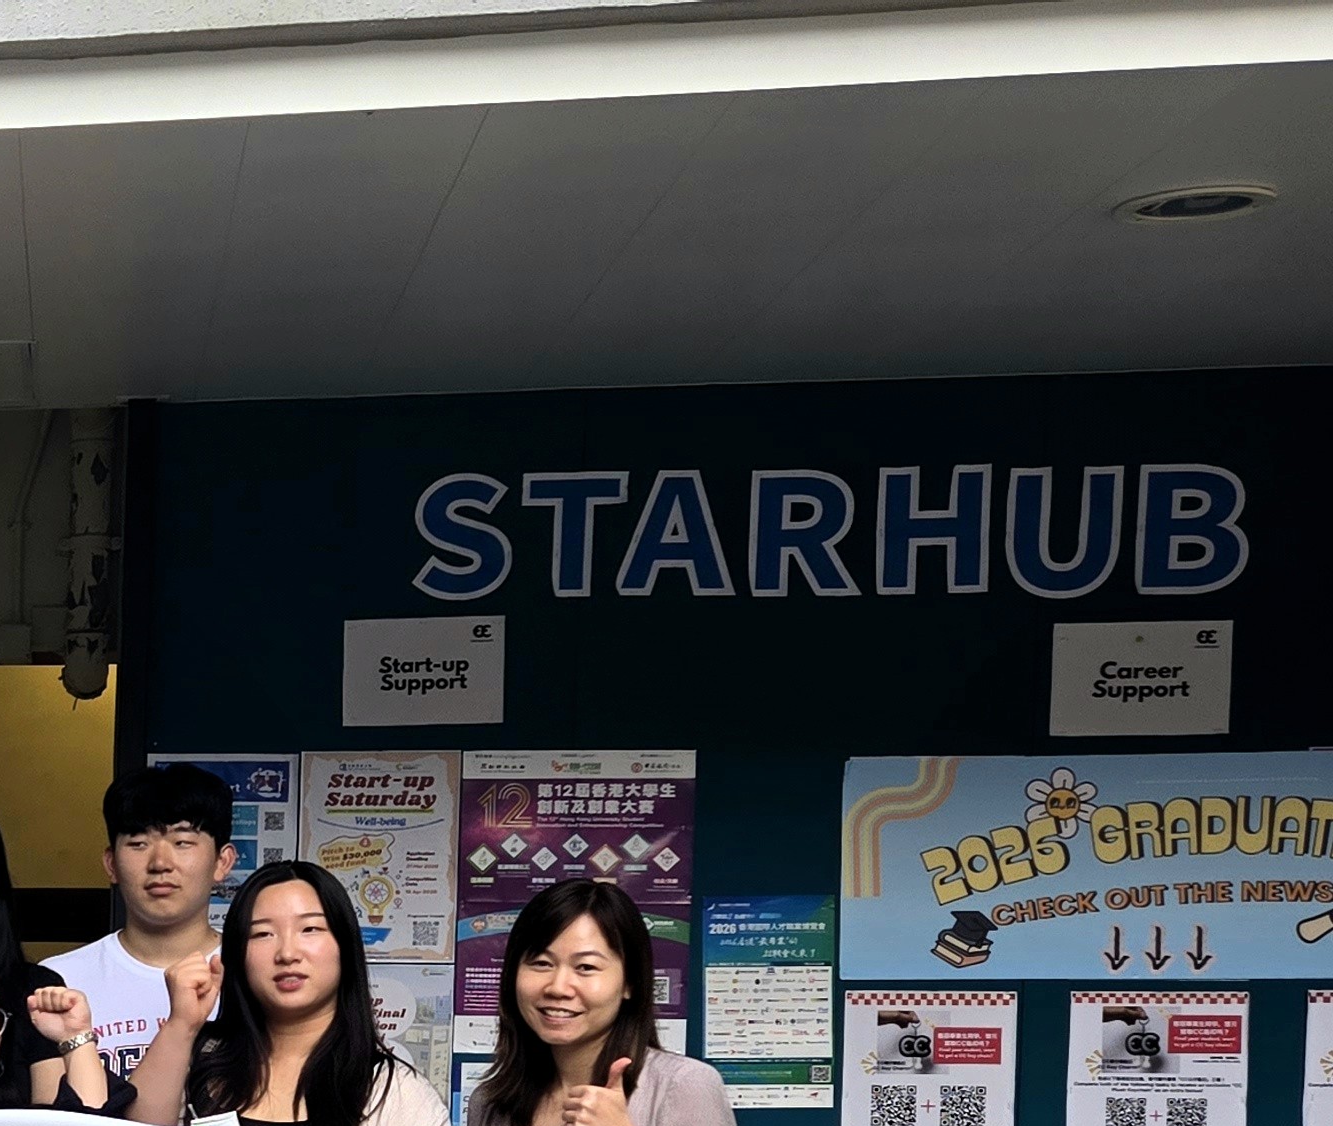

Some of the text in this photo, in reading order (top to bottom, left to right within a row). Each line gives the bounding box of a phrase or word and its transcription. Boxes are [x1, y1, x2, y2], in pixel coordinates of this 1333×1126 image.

[412, 464, 1250, 600] STARHUB
[379, 656, 469, 676] Start-up
[1100, 661, 1184, 679] Career
[380, 674, 468, 695] Support
[1092, 680, 1190, 703] Support
[328, 774, 435, 791] Start-up
[324, 791, 437, 809] Saturday
[355, 816, 406, 826] Well-being
[920, 796, 1333, 905] 2026 GRADUAT
[991, 891, 1099, 926] CHECK
[1105, 884, 1169, 910] OUT
[1174, 881, 1233, 904] THE
[709, 923, 736, 934] 2026
[93, 1018, 148, 1038] NITED
